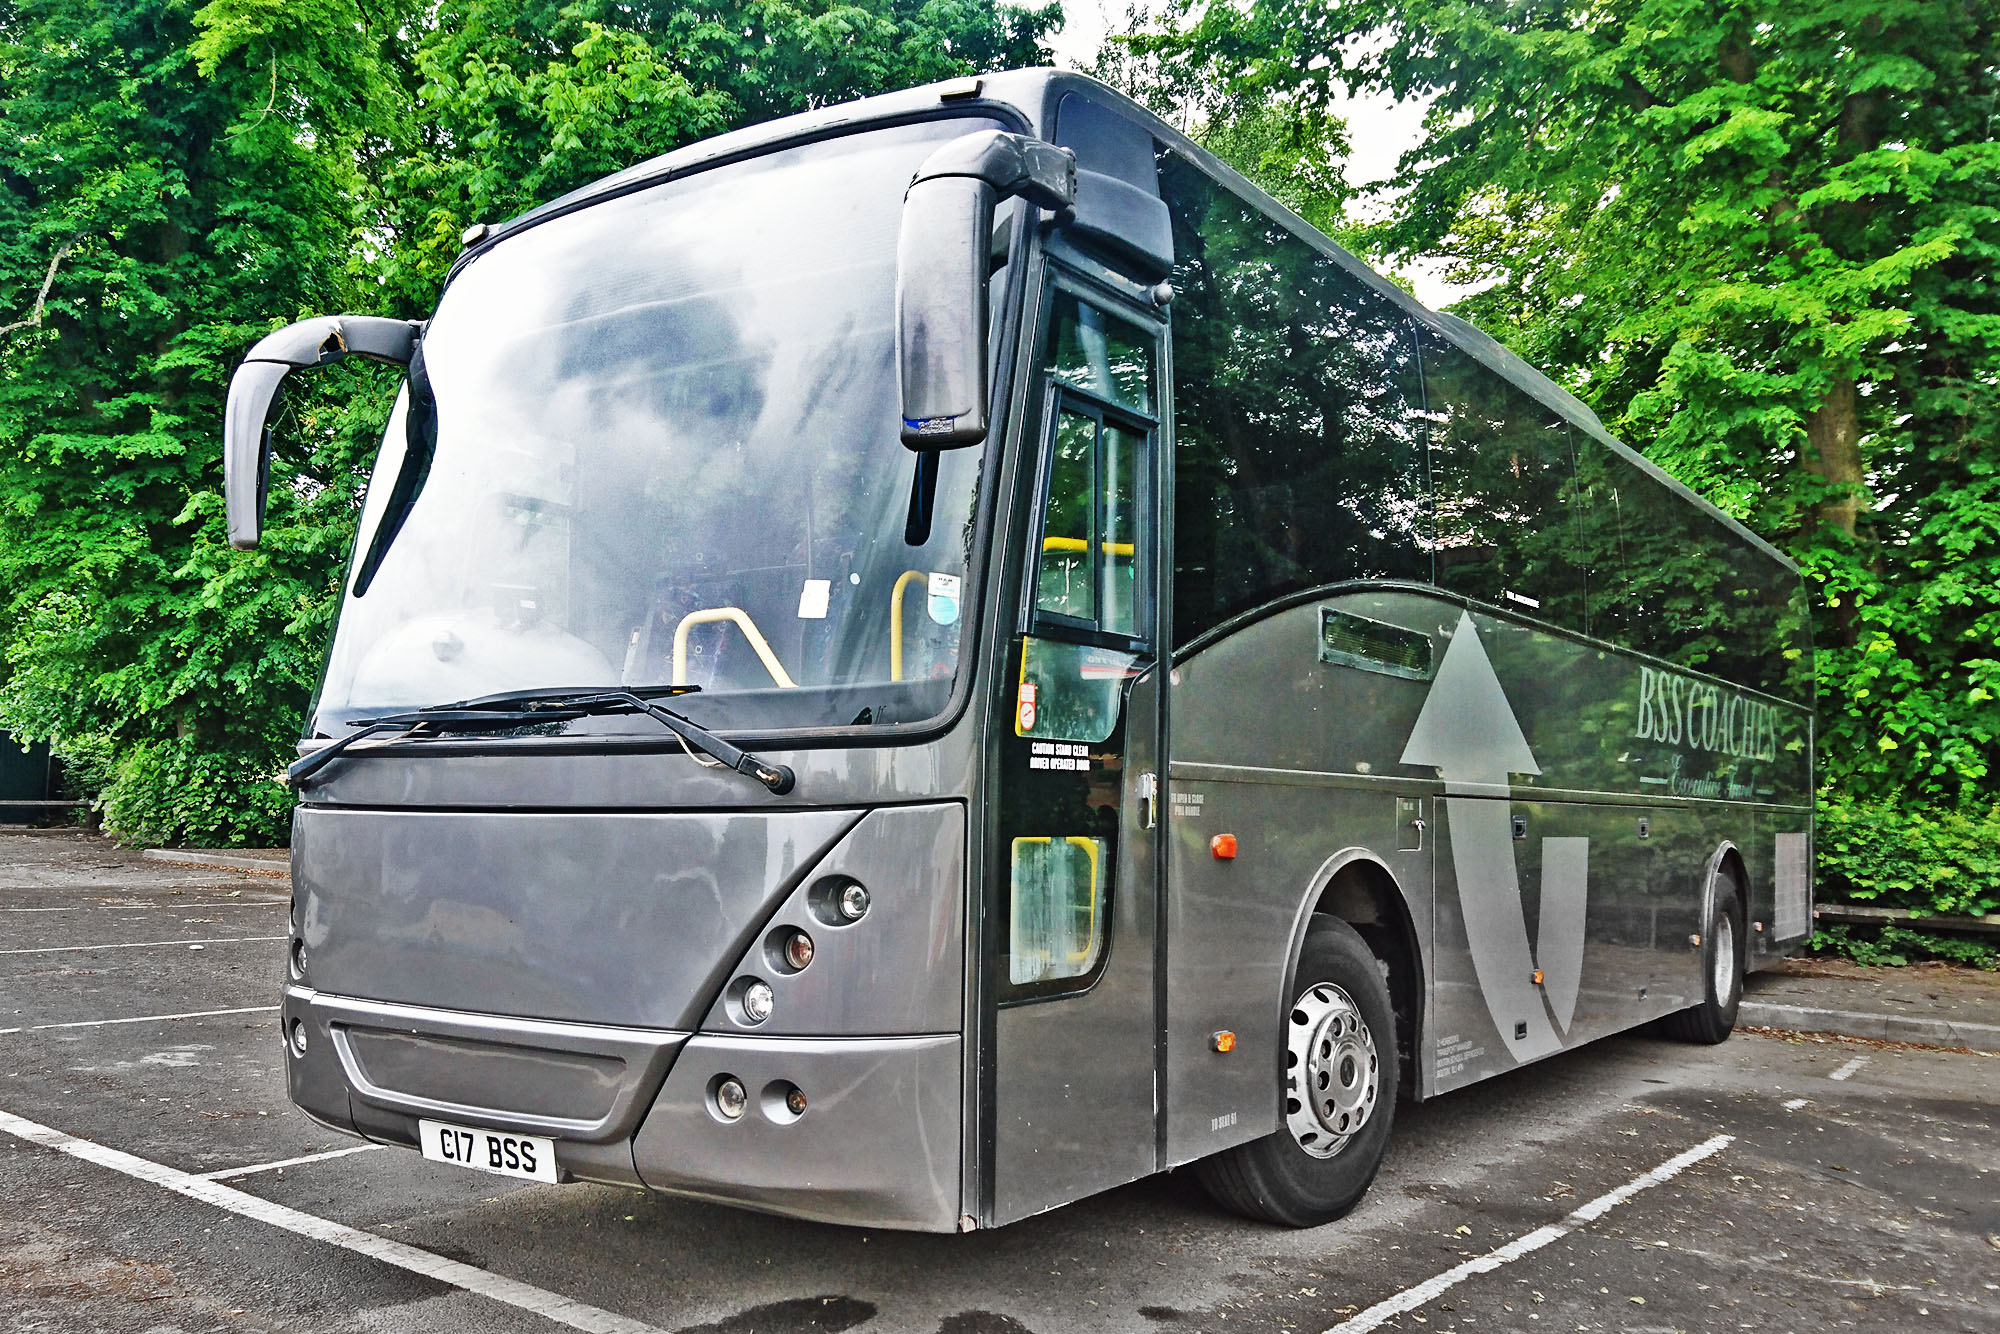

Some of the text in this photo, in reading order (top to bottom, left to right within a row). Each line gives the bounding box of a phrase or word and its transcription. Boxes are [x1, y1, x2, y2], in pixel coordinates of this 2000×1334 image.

[1635, 666, 1778, 763] BSS COACHES
[1073, 745, 1089, 757] CLEAR
[440, 1128, 537, 1173] C17 BSS
